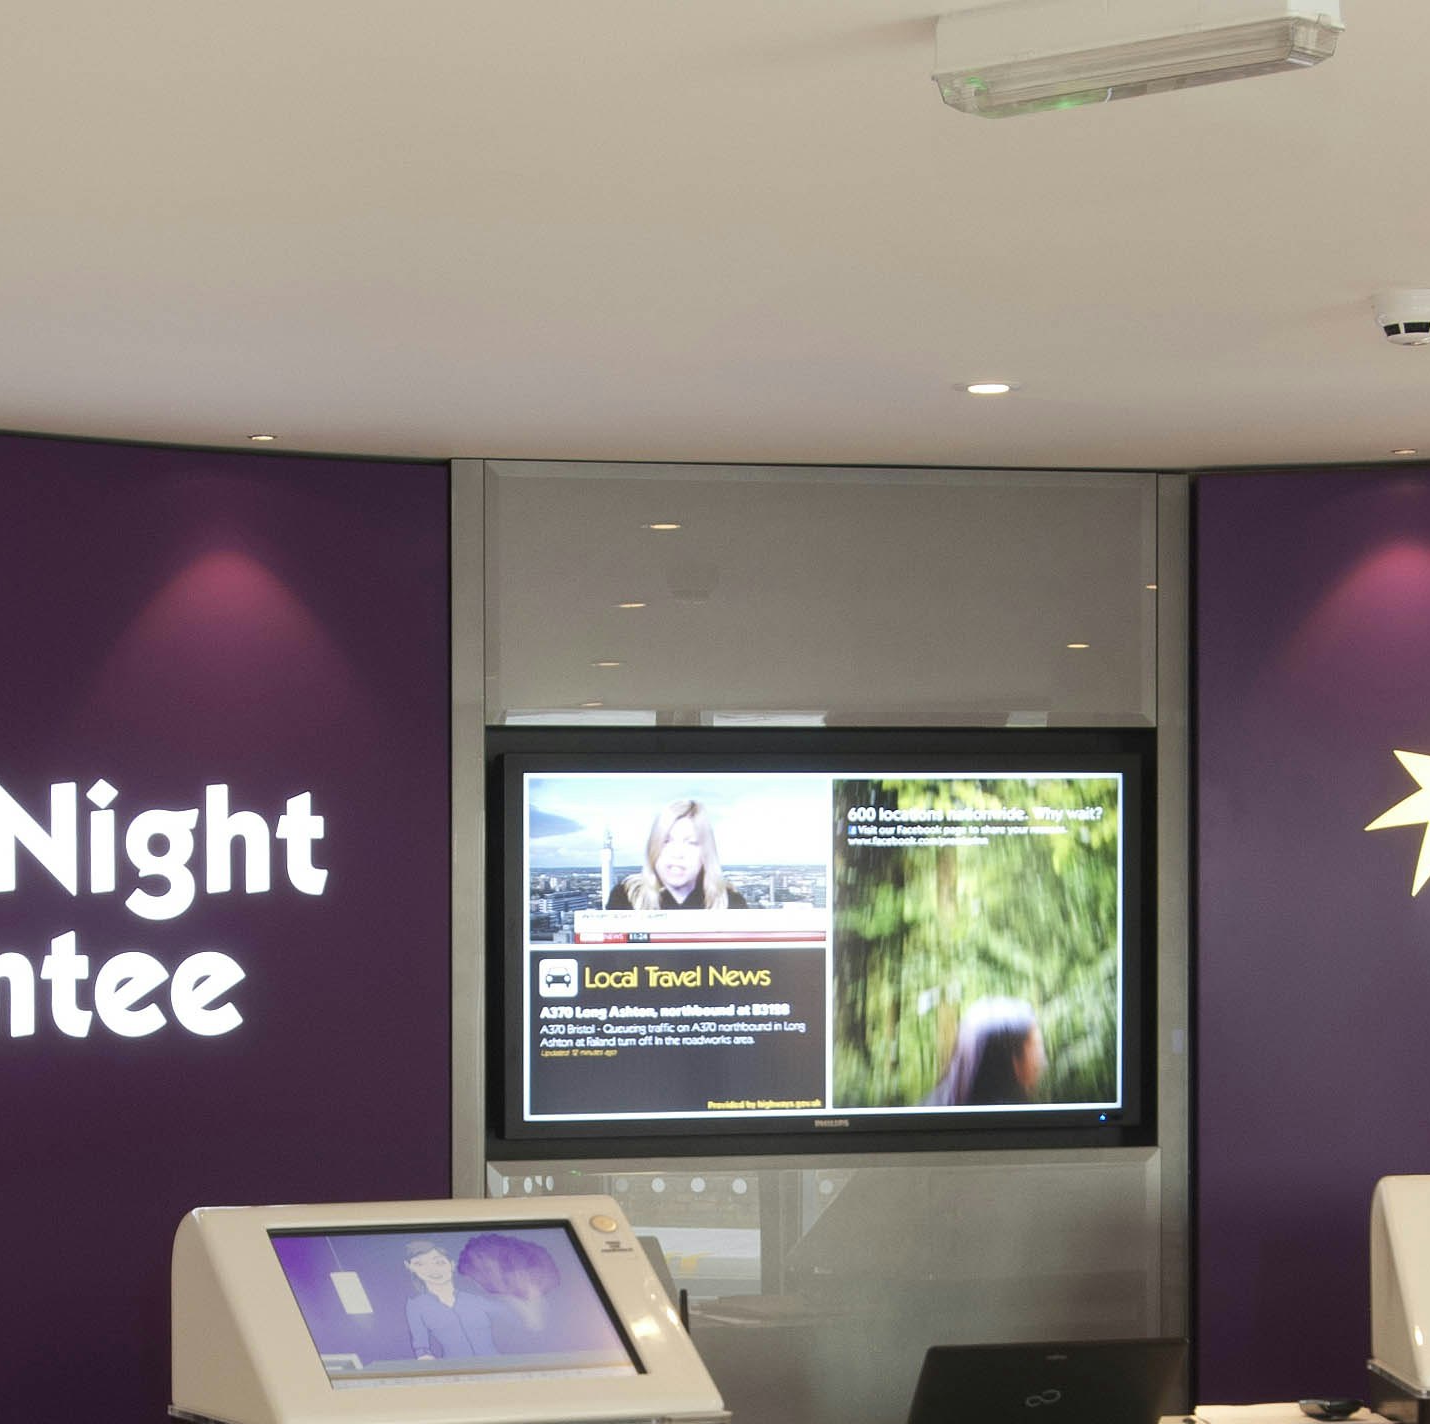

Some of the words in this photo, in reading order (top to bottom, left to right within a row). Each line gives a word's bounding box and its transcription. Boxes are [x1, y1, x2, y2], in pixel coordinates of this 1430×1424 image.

[847, 807, 876, 822] 600
[878, 807, 944, 822] locations
[946, 807, 1029, 822] nationwide.
[1032, 807, 1063, 823] Why
[1067, 806, 1103, 821] wait?
[858, 825, 878, 836] Visit
[879, 827, 896, 836] our
[896, 825, 942, 836] Facebook
[943, 826, 967, 837] page
[968, 825, 979, 835] to
[980, 824, 1006, 835] share
[1007, 825, 1029, 836] your
[585, 966, 638, 988] Local
[644, 966, 702, 988] Travel
[709, 965, 772, 987] News
[540, 1006, 573, 1019] A370
[575, 1007, 607, 1021] Long
[609, 1006, 658, 1018] Ashton,
[660, 1004, 734, 1017] northbound
[736, 1005, 750, 1016] at
[540, 1024, 566, 1036] A370
[567, 1024, 596, 1035] Bristol
[648, 1023, 675, 1034] traffic
[676, 1024, 690, 1034] on
[691, 1023, 716, 1034] A370
[718, 1022, 773, 1033] northbound
[774, 1022, 782, 1032] in
[783, 1021, 806, 1034] Long
[540, 1038, 573, 1047] Ashton
[575, 1038, 585, 1046] at
[617, 1037, 637, 1046] turn
[664, 1036, 681, 1046] the
[682, 1035, 732, 1045] roadworks
[733, 1036, 755, 1045] area.
[707, 1100, 745, 1110] Provided
